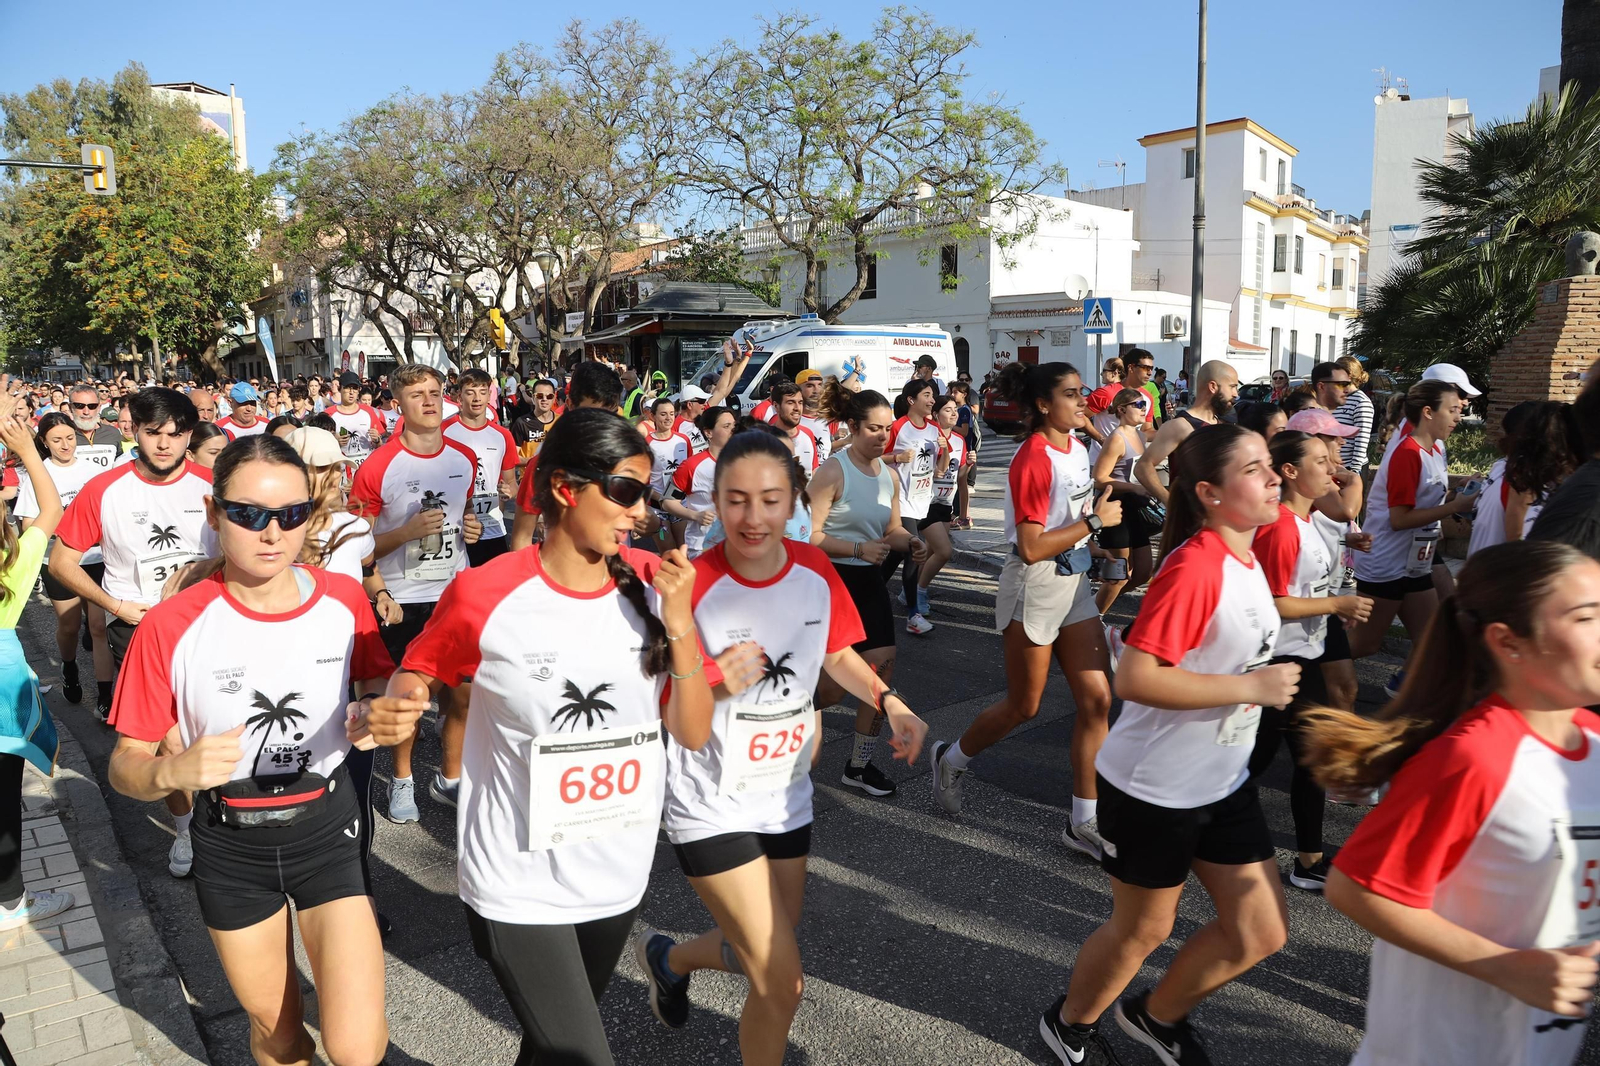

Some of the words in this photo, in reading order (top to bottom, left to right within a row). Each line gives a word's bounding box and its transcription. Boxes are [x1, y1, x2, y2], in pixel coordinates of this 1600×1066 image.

[893, 338, 942, 348] AMBULANCIA
[995, 350, 1011, 360] BAR
[86, 456, 108, 467] 80
[915, 477, 931, 490] 778
[472, 501, 492, 515] 17
[153, 560, 197, 582] 31
[232, 671, 245, 679] PALO
[748, 723, 805, 761] 628
[276, 745, 300, 753] PALO
[270, 753, 294, 764] 45
[559, 758, 641, 804] 680
[1577, 859, 1600, 911] 5
